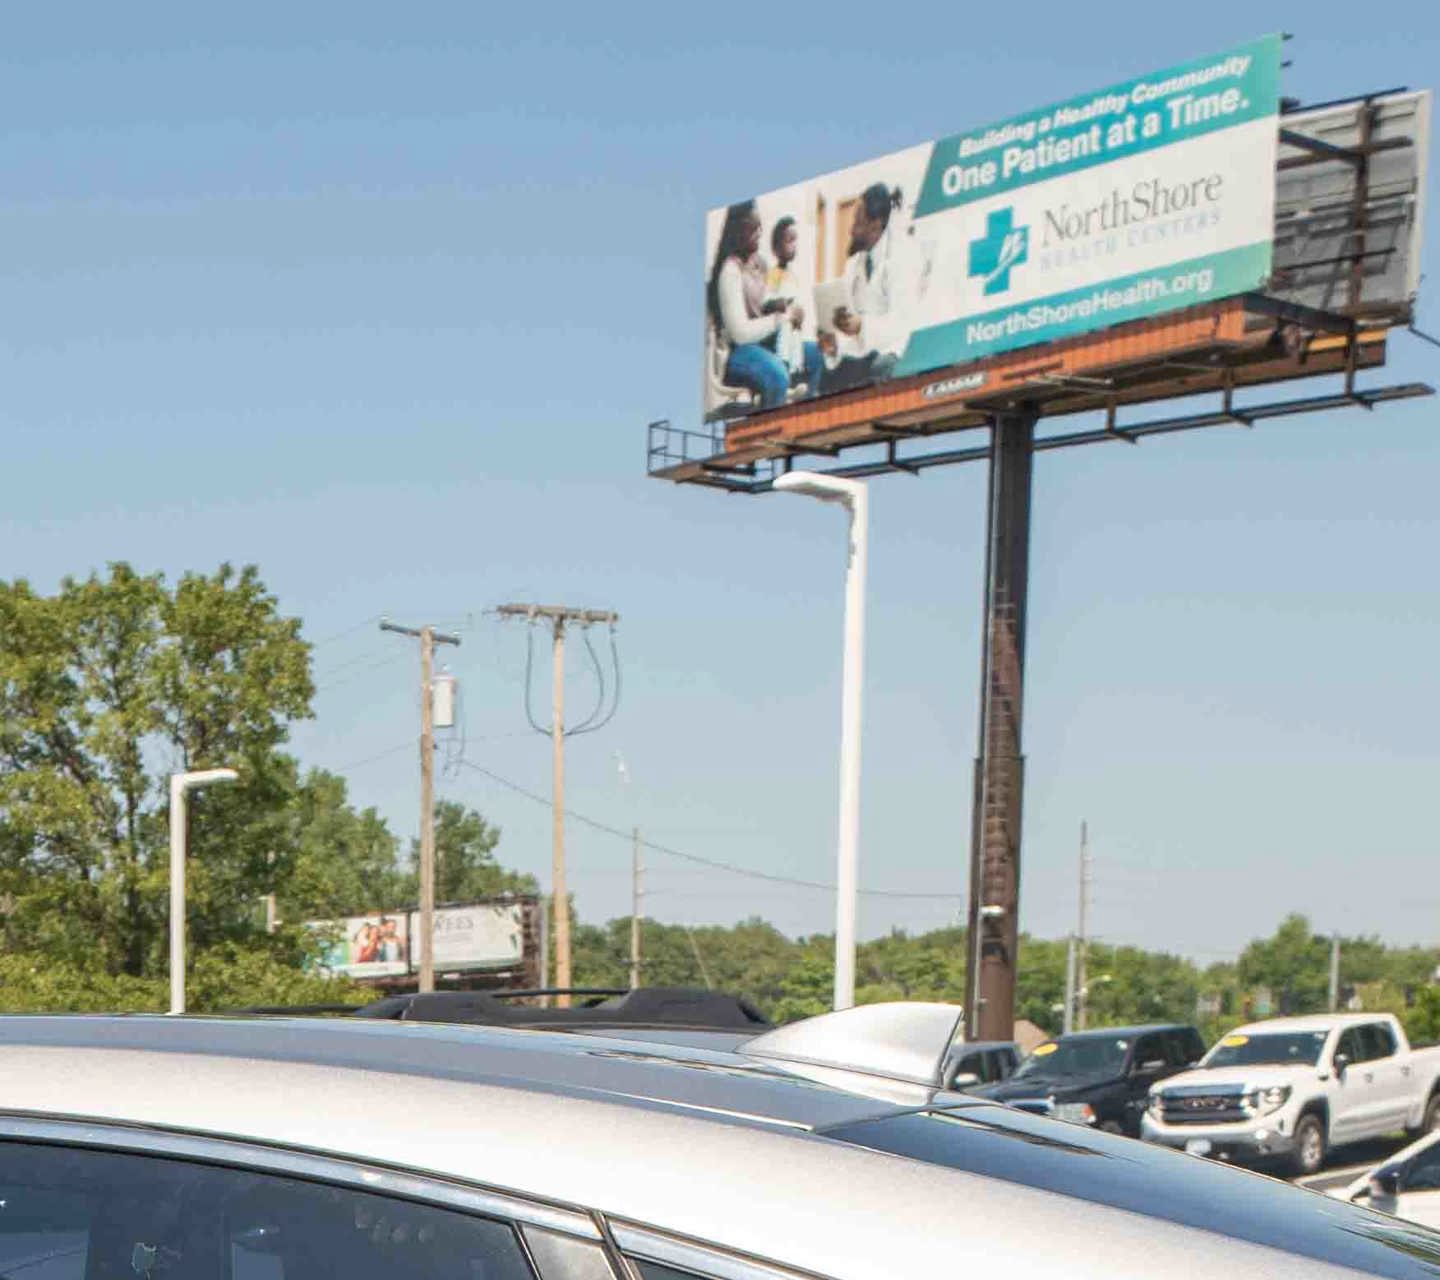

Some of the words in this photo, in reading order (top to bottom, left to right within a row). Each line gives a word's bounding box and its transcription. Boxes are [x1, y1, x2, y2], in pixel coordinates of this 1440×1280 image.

[942, 161, 997, 196] One
[1002, 124, 1101, 178] Patient
[1107, 112, 1136, 149] at
[1142, 111, 1161, 138] a
[1168, 87, 1250, 129] Time.
[959, 118, 1037, 157] Building
[1038, 116, 1051, 133] a
[1053, 89, 1127, 128] Healthy
[1131, 55, 1252, 105] Community
[1042, 172, 1223, 248] NorthShore
[966, 268, 1214, 345] NorthShoreHealth.org
